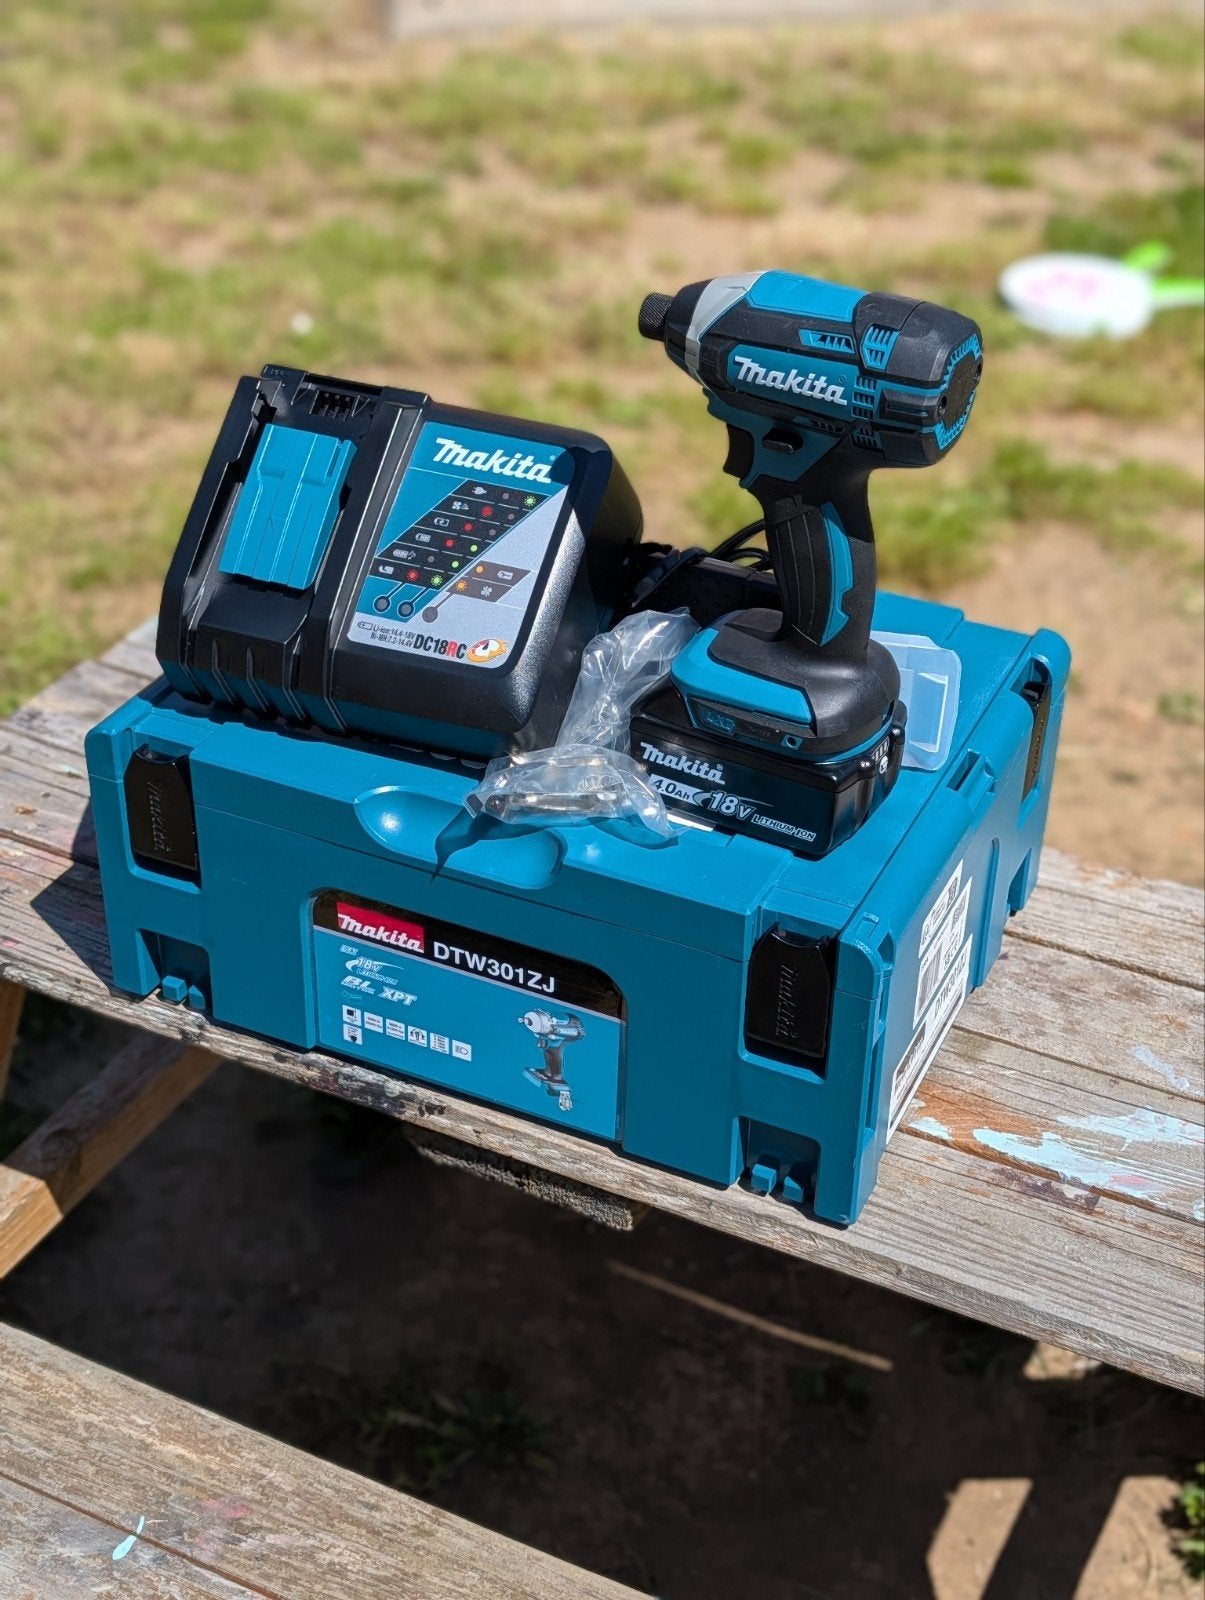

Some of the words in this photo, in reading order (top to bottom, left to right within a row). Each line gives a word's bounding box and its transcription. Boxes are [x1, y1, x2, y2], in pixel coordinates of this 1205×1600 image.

[413, 633, 467, 660] DC18RC
[653, 779, 690, 800] 4.0Ah
[751, 814, 817, 842] LITHIUM-ION
[433, 941, 556, 994] DTW301ZJ
[378, 986, 418, 1007] XPT
